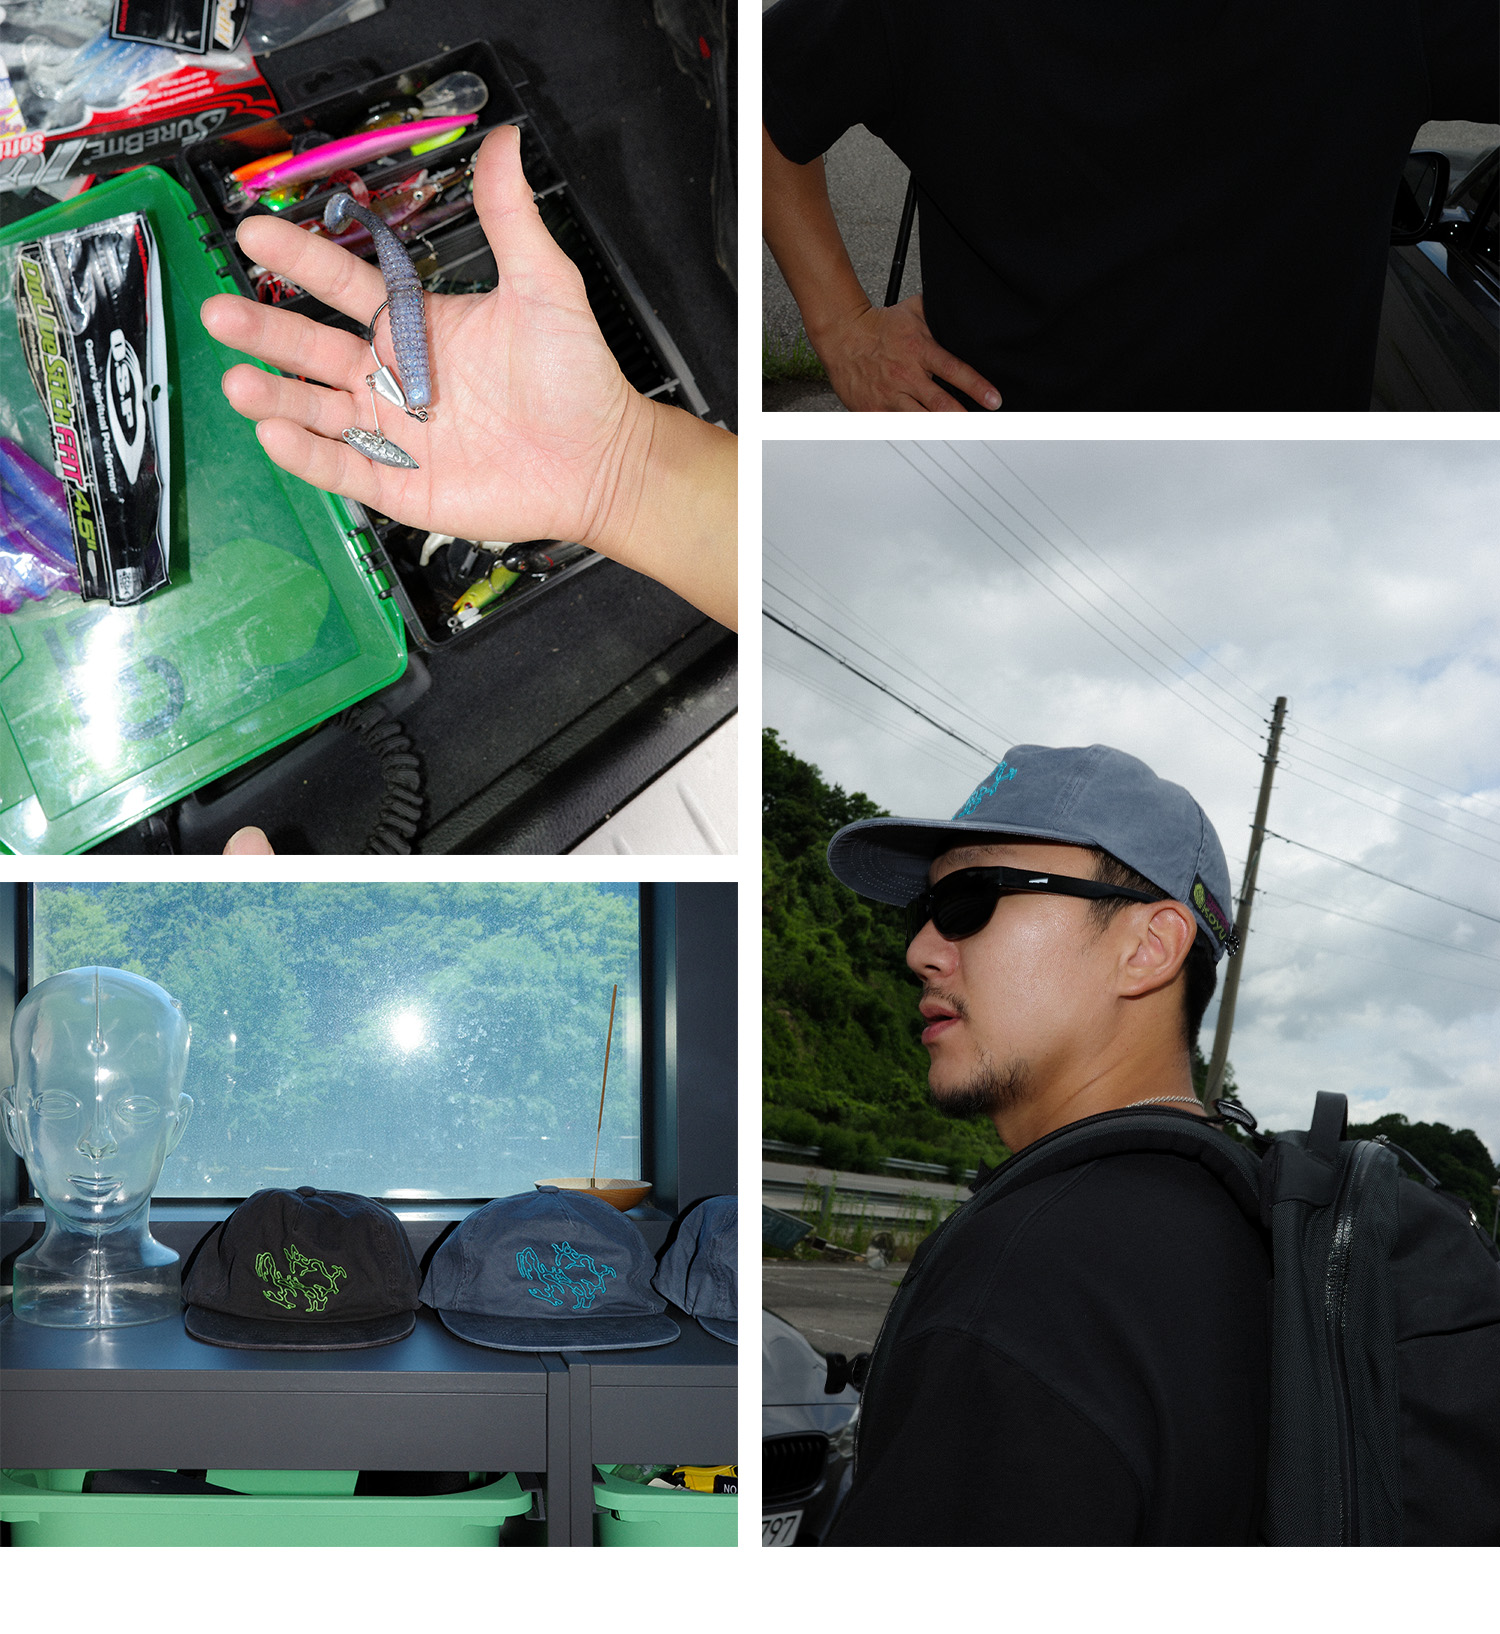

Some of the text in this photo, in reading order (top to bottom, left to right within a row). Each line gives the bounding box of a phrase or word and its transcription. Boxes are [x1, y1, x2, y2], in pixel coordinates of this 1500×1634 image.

[85, 338, 118, 494] Osprey Spiritual Performer
[54, 426, 88, 495] FAT
[1201, 904, 1226, 940] KOYU
